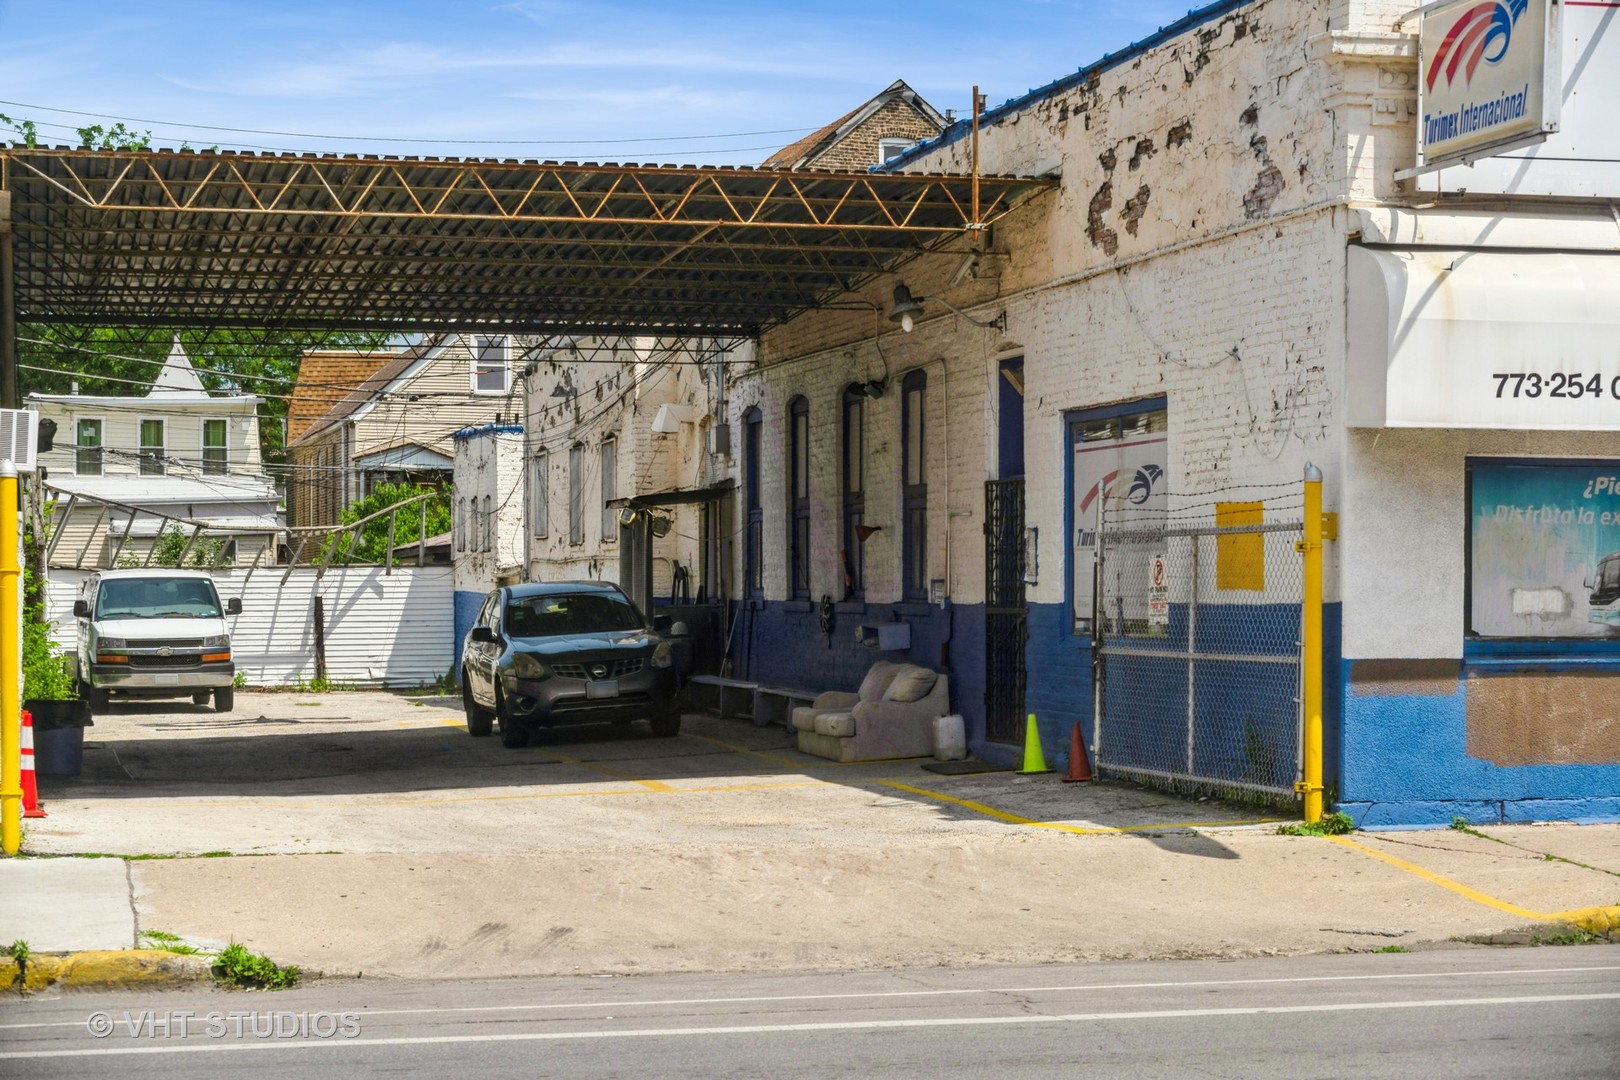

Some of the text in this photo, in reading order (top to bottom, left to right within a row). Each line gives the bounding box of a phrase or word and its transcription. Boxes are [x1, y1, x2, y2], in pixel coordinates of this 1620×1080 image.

[1423, 83, 1529, 146] Turimex Internacional
[1577, 506, 1595, 525] la
